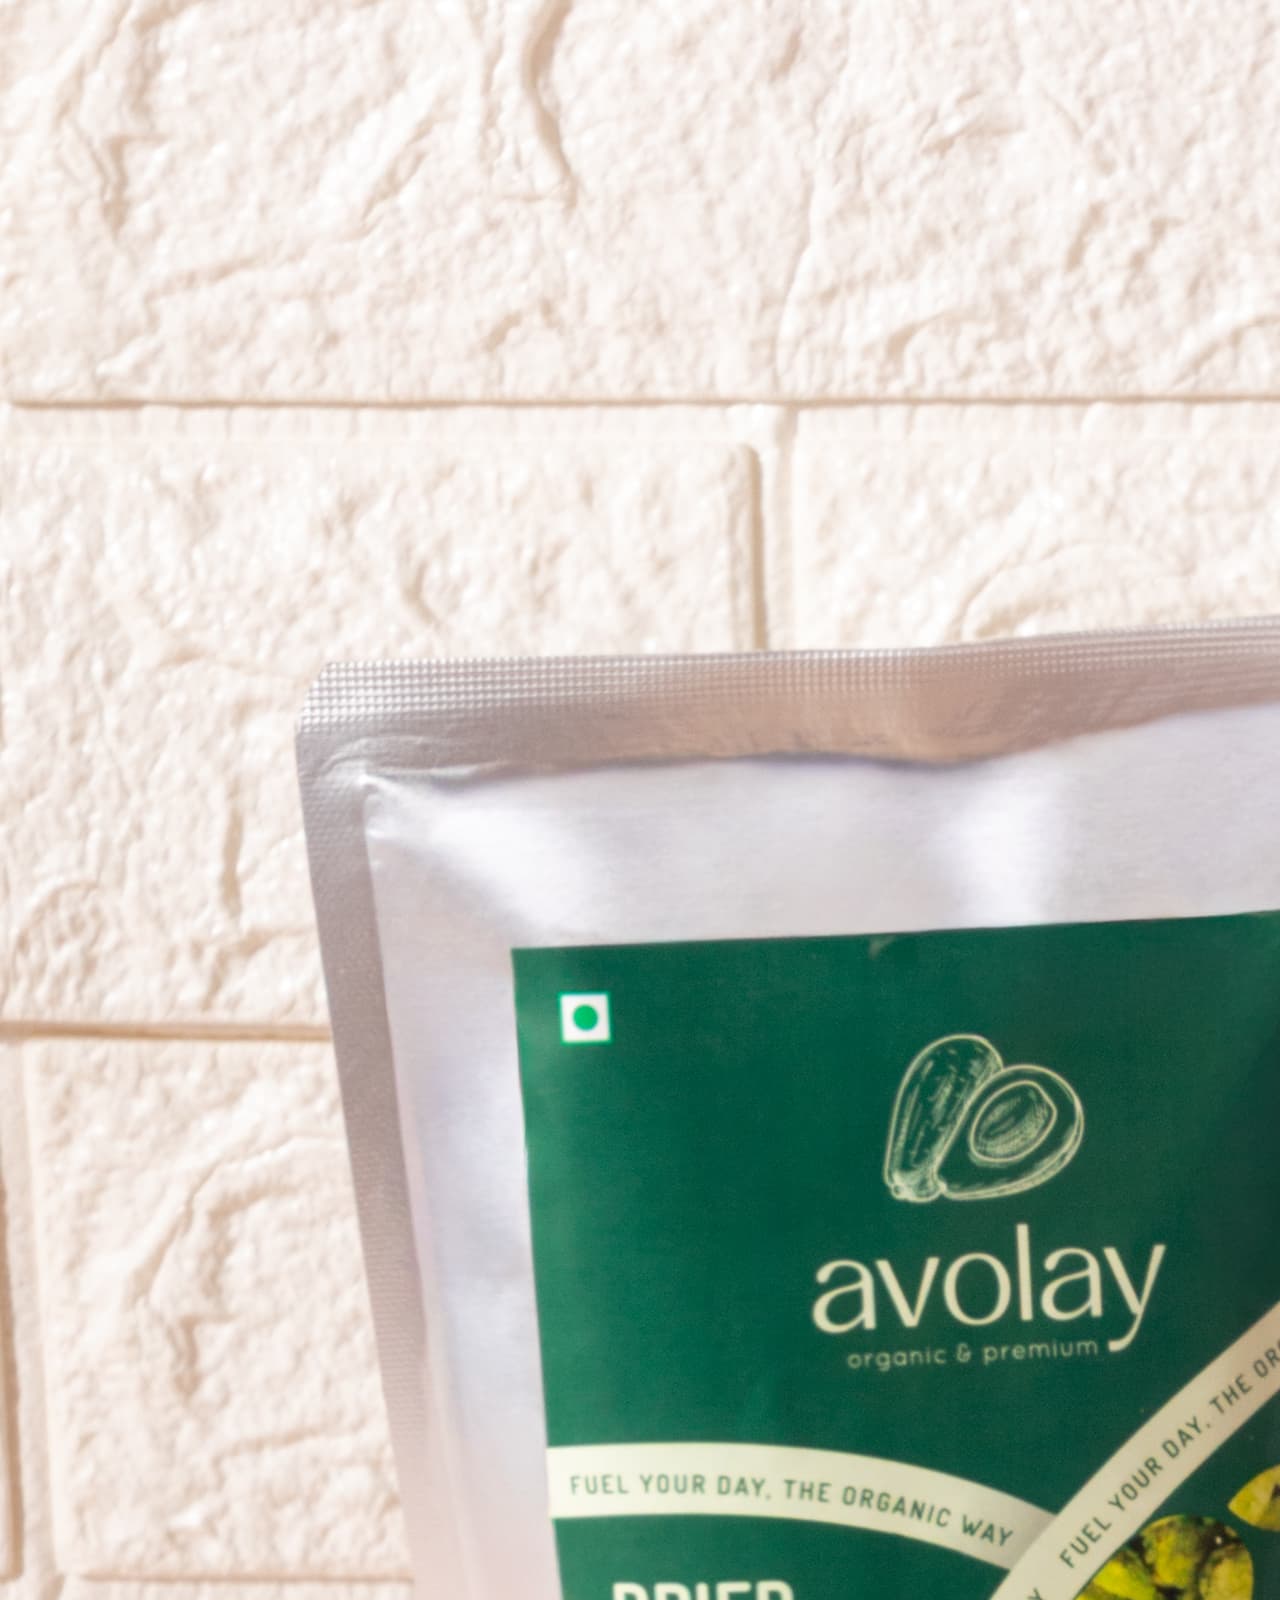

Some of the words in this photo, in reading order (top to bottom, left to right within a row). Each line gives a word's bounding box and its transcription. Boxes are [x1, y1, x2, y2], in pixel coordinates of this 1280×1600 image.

[812, 1222, 1167, 1352] avolay
[847, 1346, 947, 1372] organic
[955, 1342, 971, 1363] &
[983, 1338, 1098, 1365] premium
[570, 1475, 629, 1495] FUEL
[640, 1473, 706, 1495] YOUR
[783, 1479, 832, 1504] THE
[842, 1486, 950, 1528] ORGANIC
[960, 1514, 1015, 1548] WAY
[1059, 1518, 1113, 1568] FUEL
[1108, 1457, 1163, 1512] YOUR
[1209, 1373, 1252, 1415] THE
